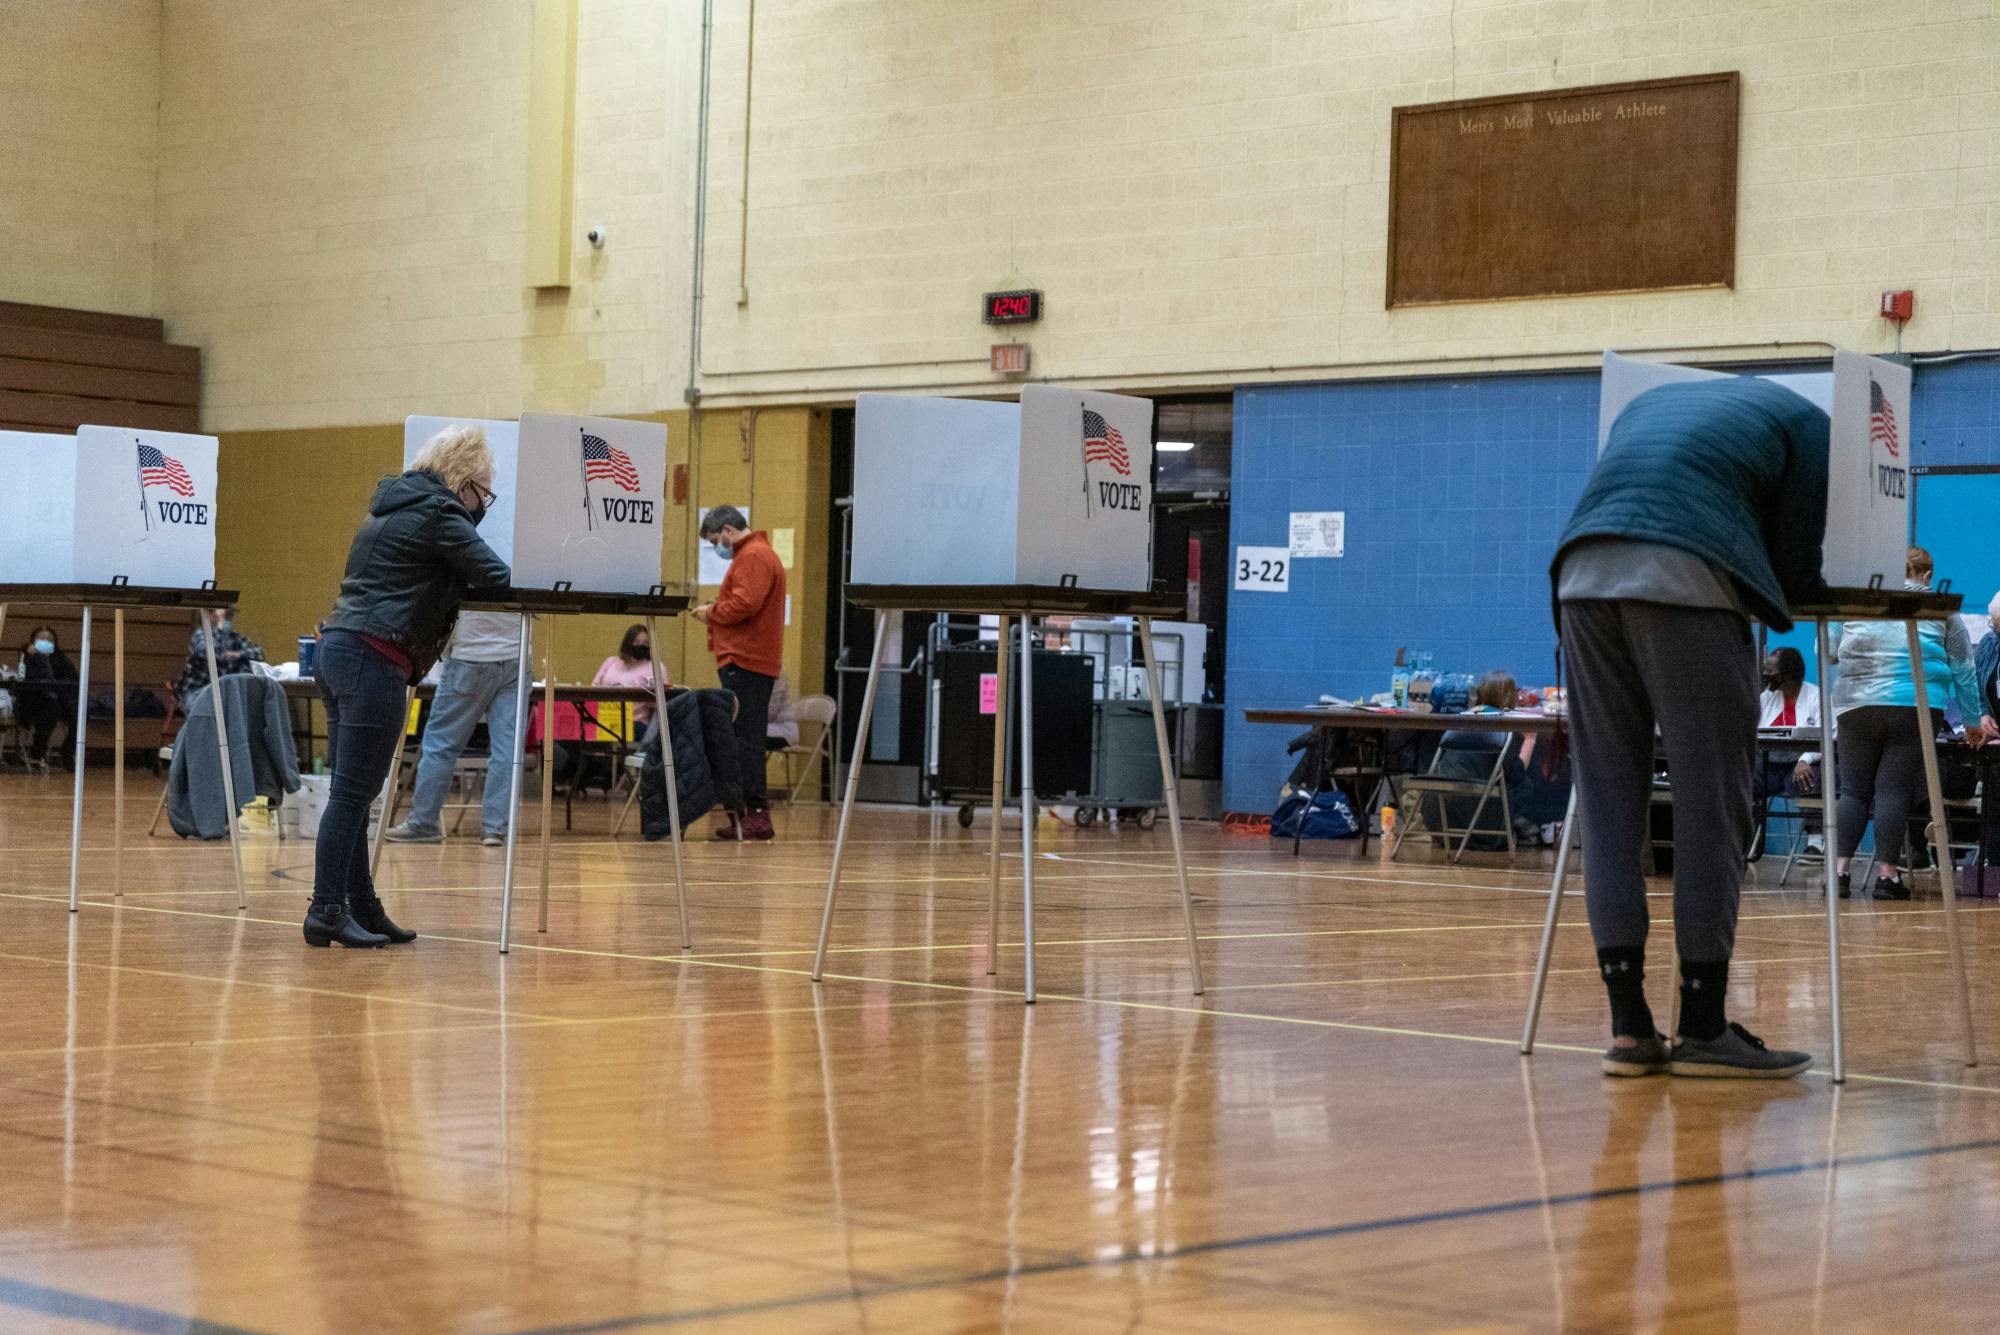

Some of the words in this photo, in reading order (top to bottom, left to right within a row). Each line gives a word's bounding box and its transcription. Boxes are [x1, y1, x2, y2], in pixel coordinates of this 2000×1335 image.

[1459, 119, 1494, 135] Men's
[1504, 114, 1534, 130] Most
[1547, 107, 1603, 126] Valuable
[1614, 102, 1667, 120] Athlete
[993, 351, 1023, 369] EXIT
[1878, 464, 1906, 499] VOTE
[1099, 481, 1142, 511] VOTE
[158, 501, 208, 525] VOTE
[602, 497, 654, 524] VOTE
[1238, 559, 1285, 582] 3-22
